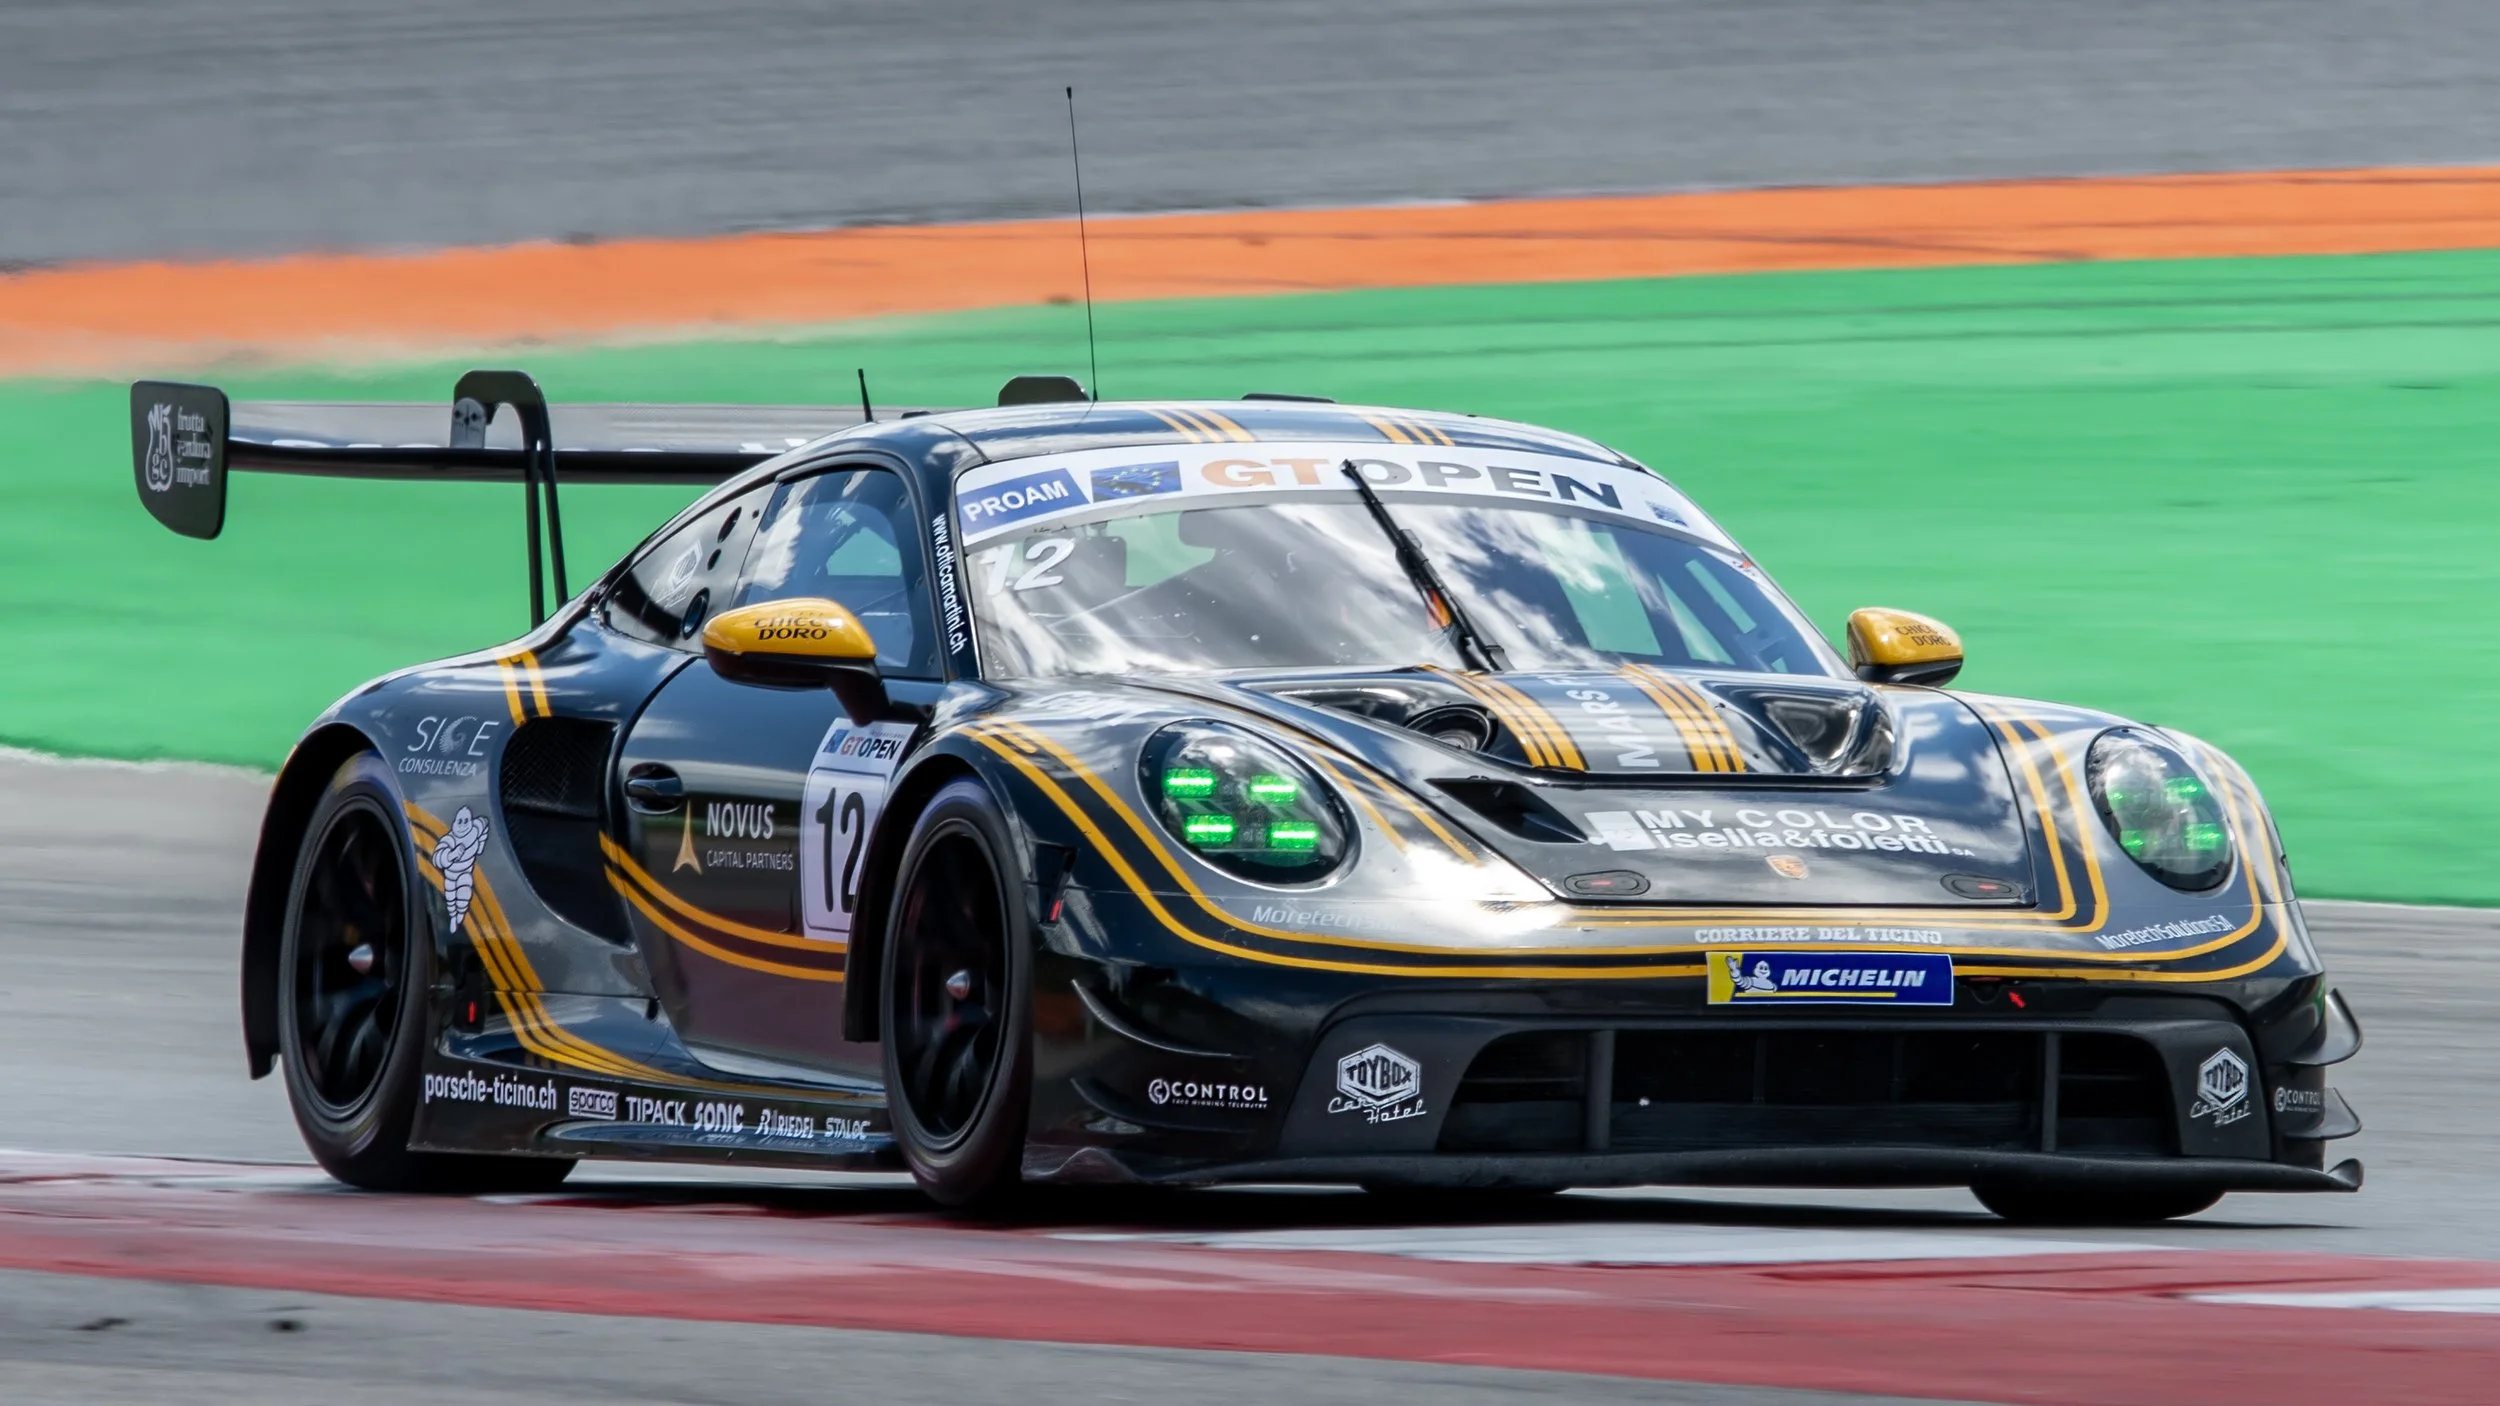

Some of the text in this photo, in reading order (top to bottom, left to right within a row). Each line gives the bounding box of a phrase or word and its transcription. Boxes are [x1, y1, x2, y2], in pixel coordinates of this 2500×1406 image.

[963, 480, 1069, 522] PROAM
[980, 537, 1076, 596] 12
[398, 757, 478, 777] CONSULENZA
[707, 802, 775, 841] NOVUS
[1637, 809, 1933, 835] MY COLOR
[707, 850, 794, 872] CAPITAL PARTNERS
[815, 787, 866, 914] 12
[1695, 927, 1943, 945] CORRIERE DEL TICINO
[1781, 968, 1927, 988] MICHELIN
[1345, 1054, 1413, 1091] TOYBOX
[424, 1071, 557, 1110] porsche-ticino.ch
[570, 1090, 617, 1114] sparco
[1171, 1081, 1268, 1102] CONTROL
[625, 1096, 686, 1127] TIPACK
[1327, 1096, 1427, 1124] Car Hotel
[777, 1114, 815, 1139] RIEDEL
[825, 1117, 873, 1141] STALOC
